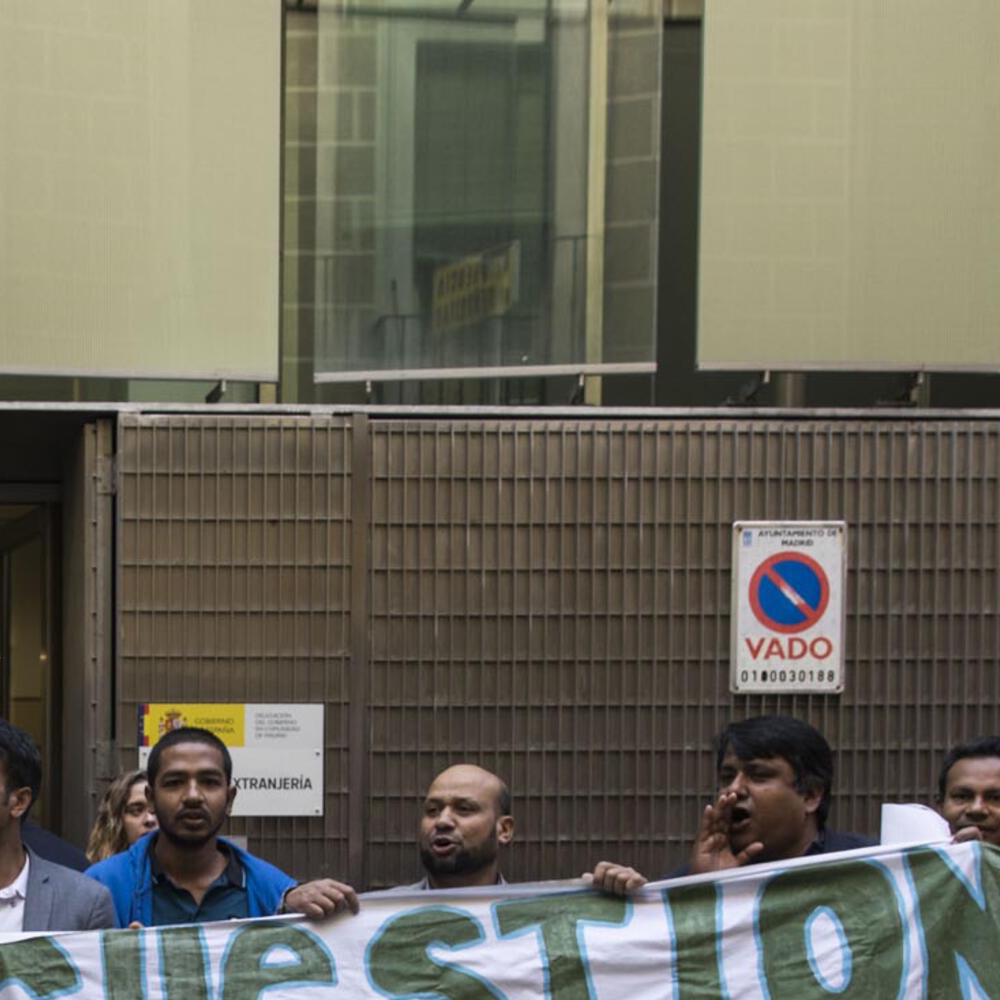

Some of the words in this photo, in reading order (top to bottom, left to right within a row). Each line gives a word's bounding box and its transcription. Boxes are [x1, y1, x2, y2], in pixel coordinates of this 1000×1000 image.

[758, 528, 825, 537] AYUNTAMIENTO
[781, 539, 814, 547] MADRID
[745, 636, 834, 661] VADO
[233, 774, 313, 790] XTRANJERÍA
